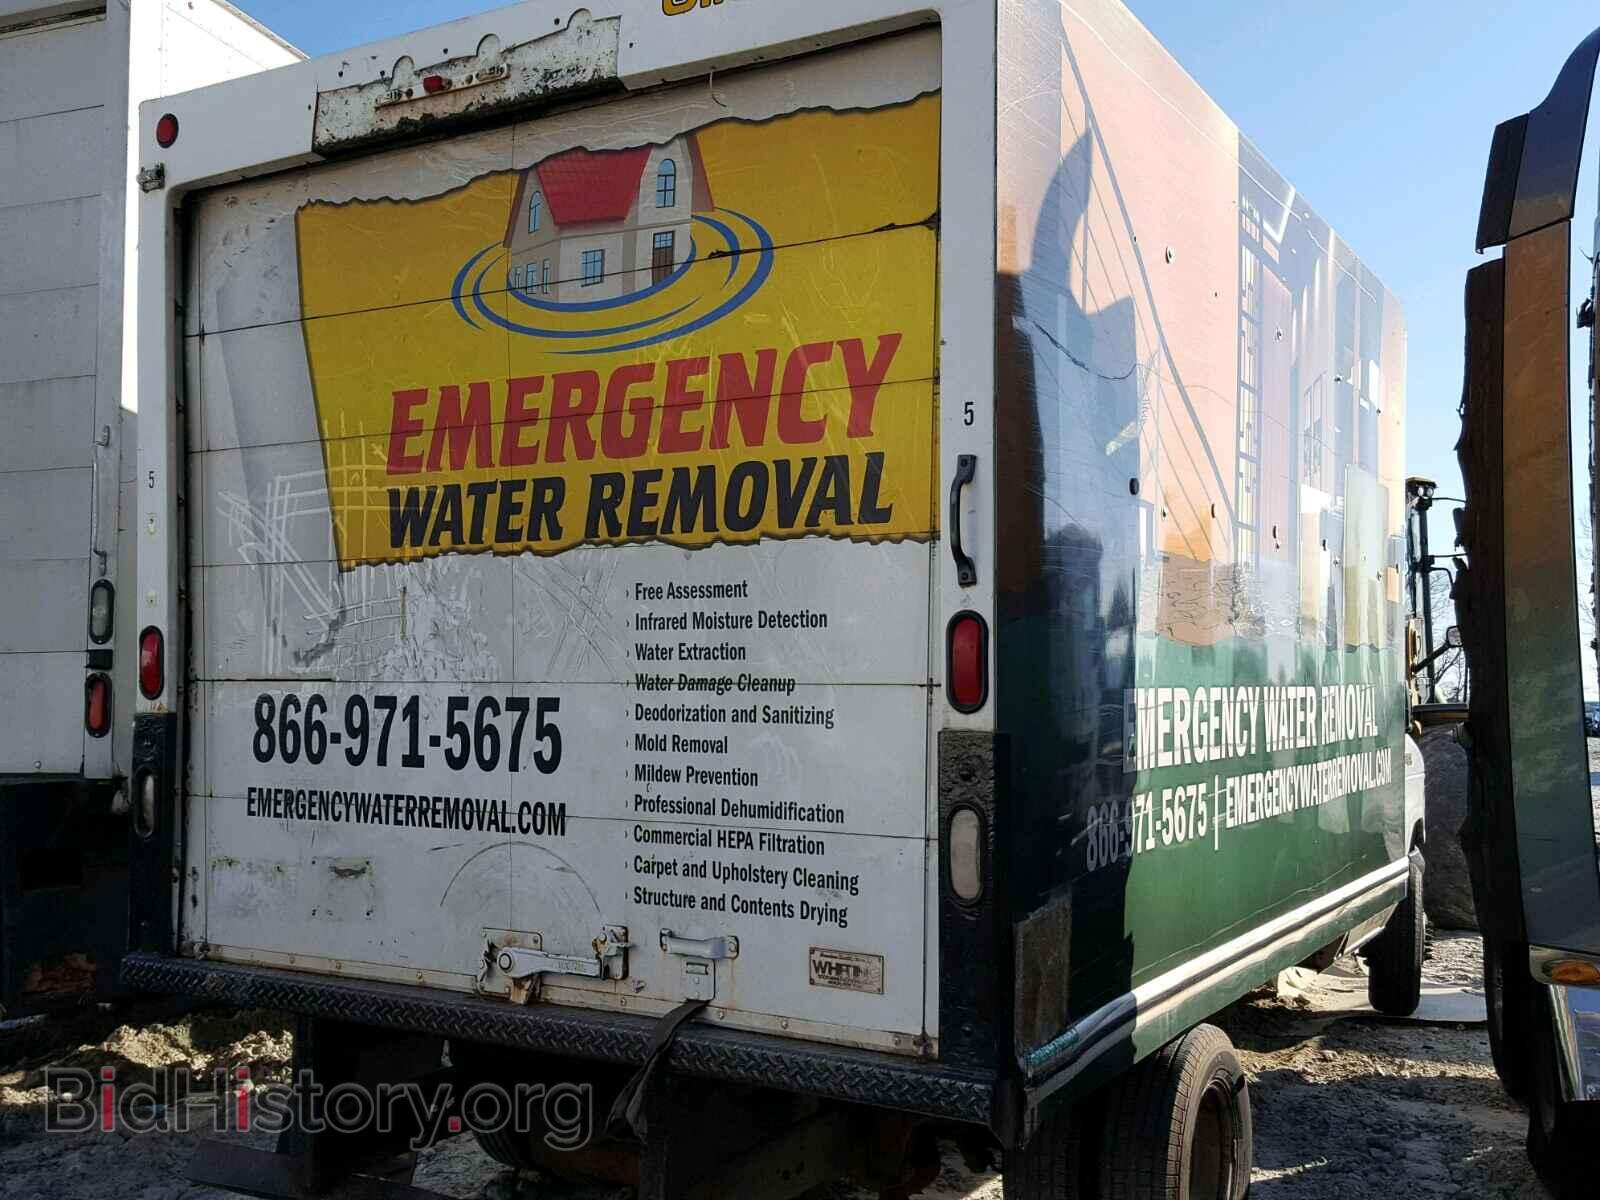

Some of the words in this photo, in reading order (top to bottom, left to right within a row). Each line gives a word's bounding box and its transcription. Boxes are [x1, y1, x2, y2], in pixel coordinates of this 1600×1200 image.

[386, 333, 902, 476] EMERGENCY
[964, 401, 974, 426] 5
[148, 470, 155, 489] 5
[387, 476, 566, 548] WATER
[584, 452, 893, 539] REMOVAL
[635, 582, 664, 600] Free
[667, 580, 748, 599] Assessment
[635, 612, 687, 631] Infrared
[692, 611, 753, 630] Moisture
[757, 610, 828, 629] Detection
[635, 643, 674, 660] Water
[678, 642, 746, 661] Extraction
[635, 673, 674, 691] Water
[677, 673, 733, 697] Damage
[737, 673, 796, 696] Cleanup
[635, 703, 726, 723] Deodorization
[731, 705, 757, 723] and
[762, 705, 834, 729] Sanitizing
[1123, 686, 1261, 773] EMERGENCY
[1263, 686, 1318, 752] WATER
[1321, 683, 1379, 745] REMOVAL
[252, 694, 562, 774] 866-971-5675
[635, 733, 667, 752] Mold
[672, 735, 728, 753] Removal
[634, 764, 681, 783] Mildew
[685, 766, 758, 787] Prevention
[247, 787, 566, 836] EMERGENCYWATERREMOVAL.COM
[634, 794, 716, 816] Professional
[721, 799, 844, 823] Dehumidification
[1086, 782, 1209, 872] 866-971-5675
[1226, 747, 1392, 828] EMERGENCYWATERREMOVAL.COM
[633, 825, 712, 848] Commercial
[717, 829, 754, 850] HEPA
[759, 832, 825, 855] Filtration
[633, 855, 678, 879] Carpet
[682, 860, 707, 878] and
[712, 862, 788, 891] Upholstery
[792, 867, 859, 896] Cleaning
[633, 886, 696, 909] Structure
[700, 892, 726, 911] and
[731, 895, 795, 919] Contents
[800, 900, 848, 928] Drying
